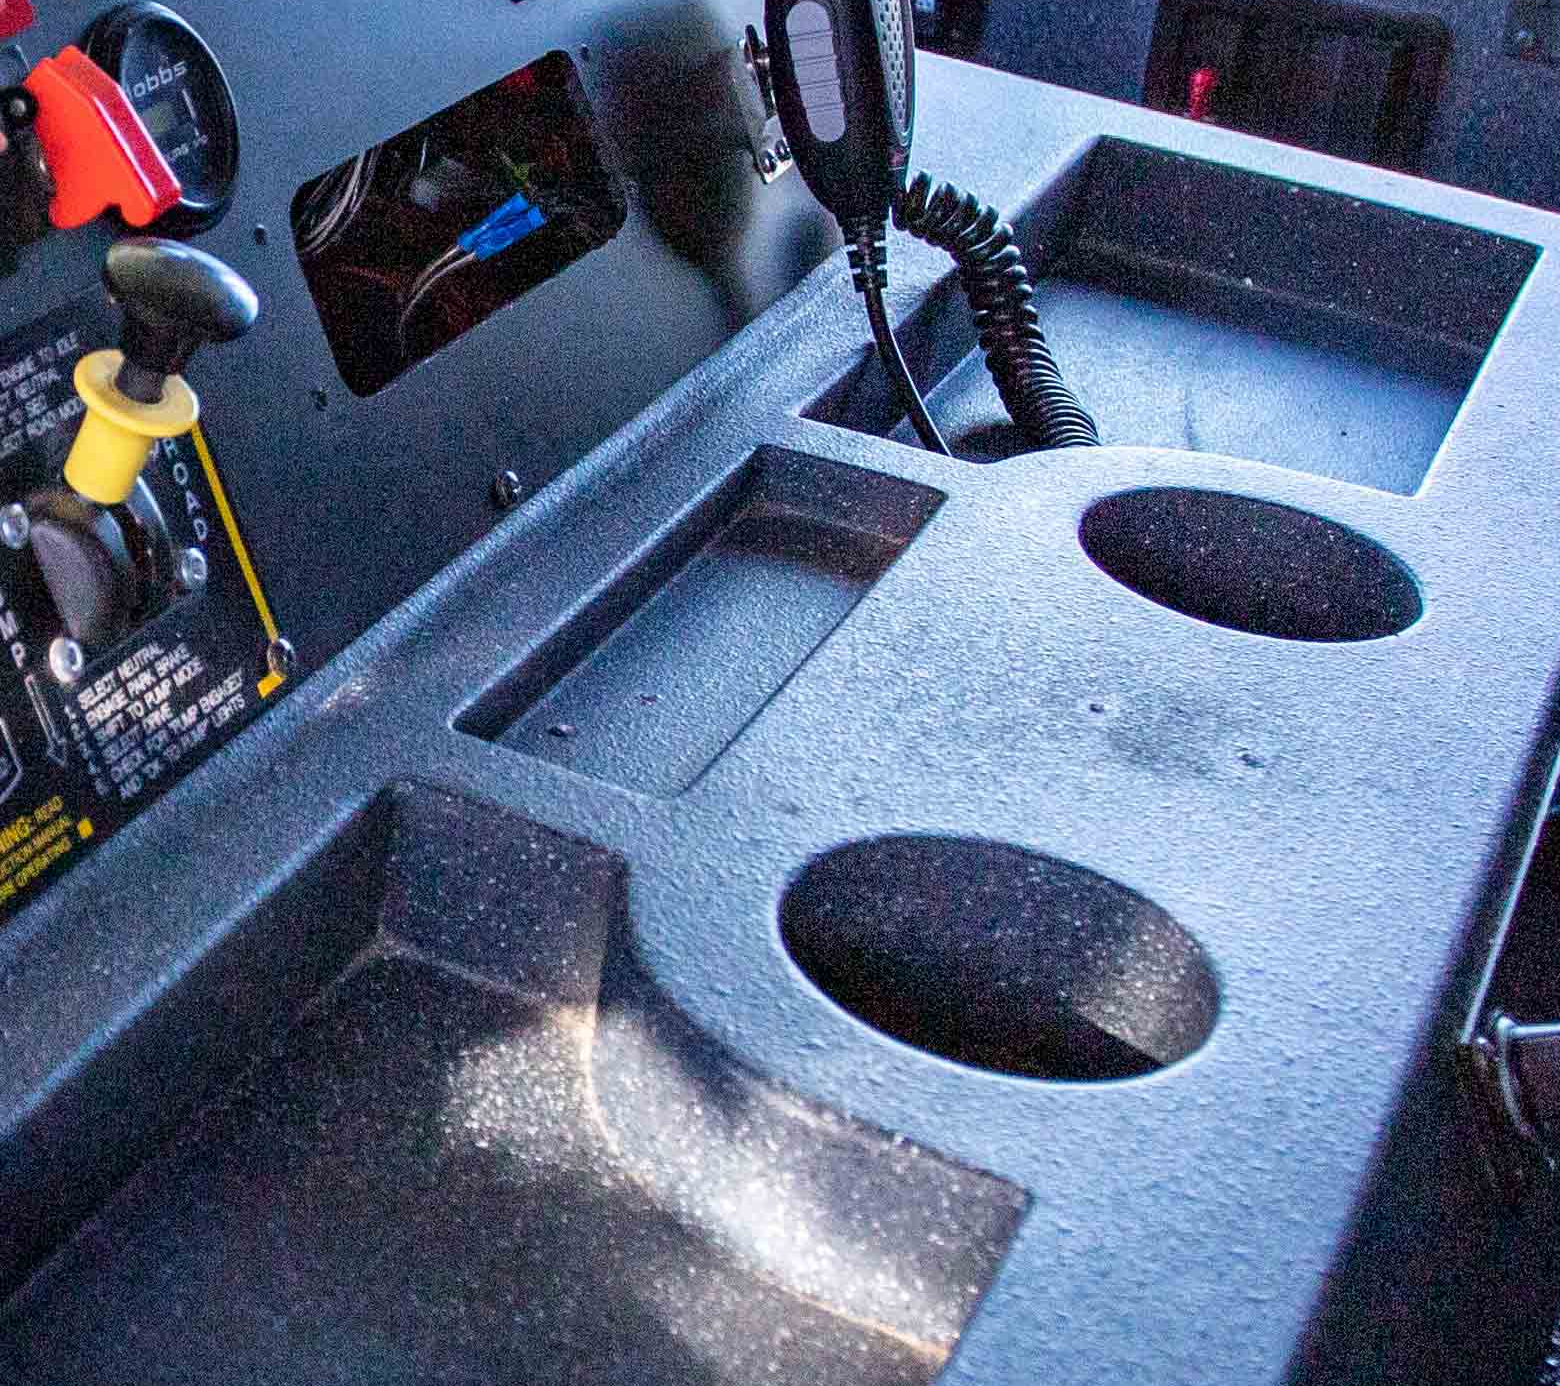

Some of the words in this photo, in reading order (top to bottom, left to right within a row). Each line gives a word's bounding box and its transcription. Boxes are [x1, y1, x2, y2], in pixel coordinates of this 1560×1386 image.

[122, 63, 185, 101] obbs
[14, 368, 61, 400] NEUTRAL
[26, 411, 58, 436] ROAD
[77, 675, 114, 710] SELECT
[117, 644, 163, 679] NEUTRAL
[86, 690, 127, 727] ENGAGE
[127, 671, 155, 694] PARK
[155, 645, 189, 677] BRAKE
[144, 679, 171, 707] PUMP
[172, 657, 203, 686] MODE
[143, 703, 172, 729] DRIVE
